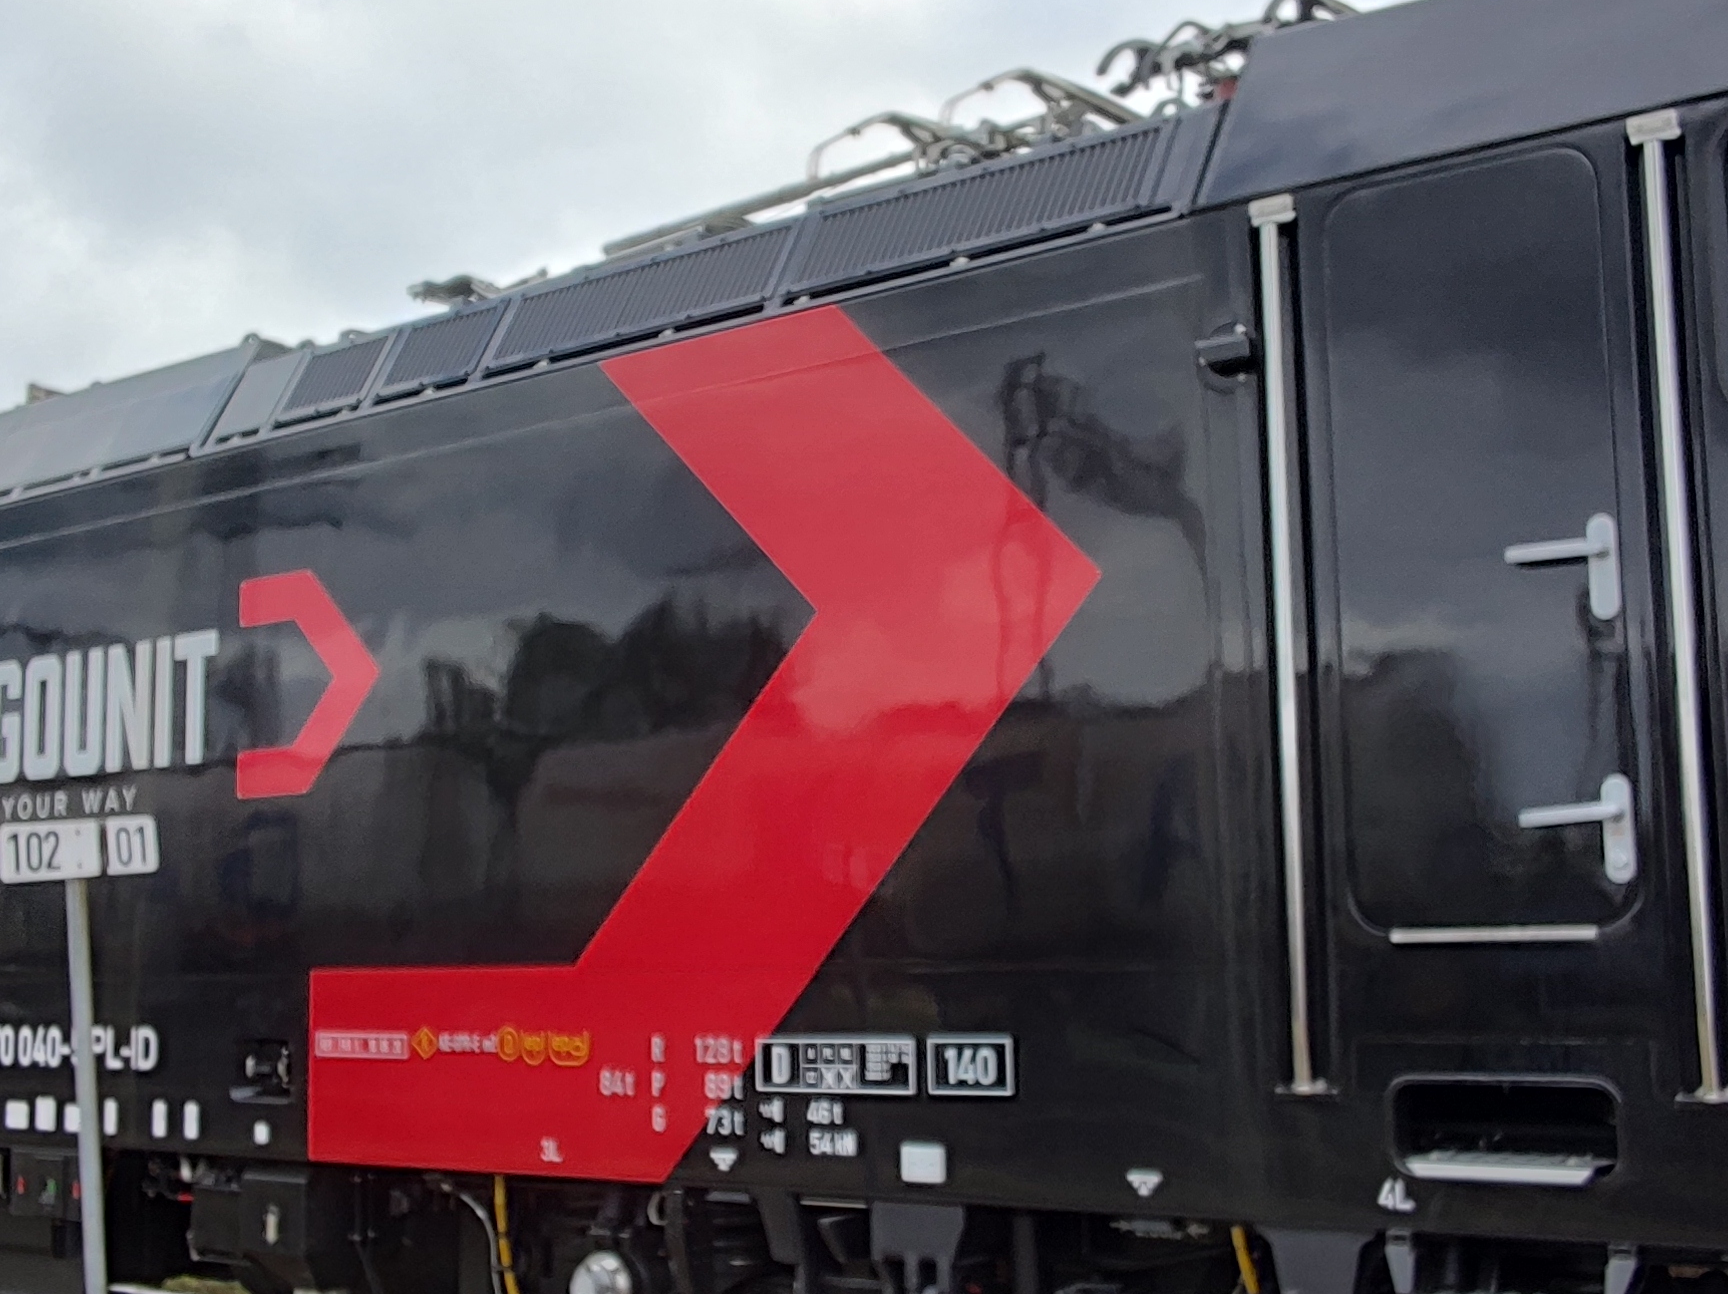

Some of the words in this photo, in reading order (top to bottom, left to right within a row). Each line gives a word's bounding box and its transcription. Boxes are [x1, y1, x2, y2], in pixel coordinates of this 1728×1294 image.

[2, 790, 69, 819] YOUR
[82, 785, 138, 814] WAY
[6, 829, 62, 875] 102
[115, 825, 148, 868] 01
[770, 1044, 792, 1085] D
[943, 1045, 999, 1086] 140
[1377, 1177, 1417, 1212] 4L
